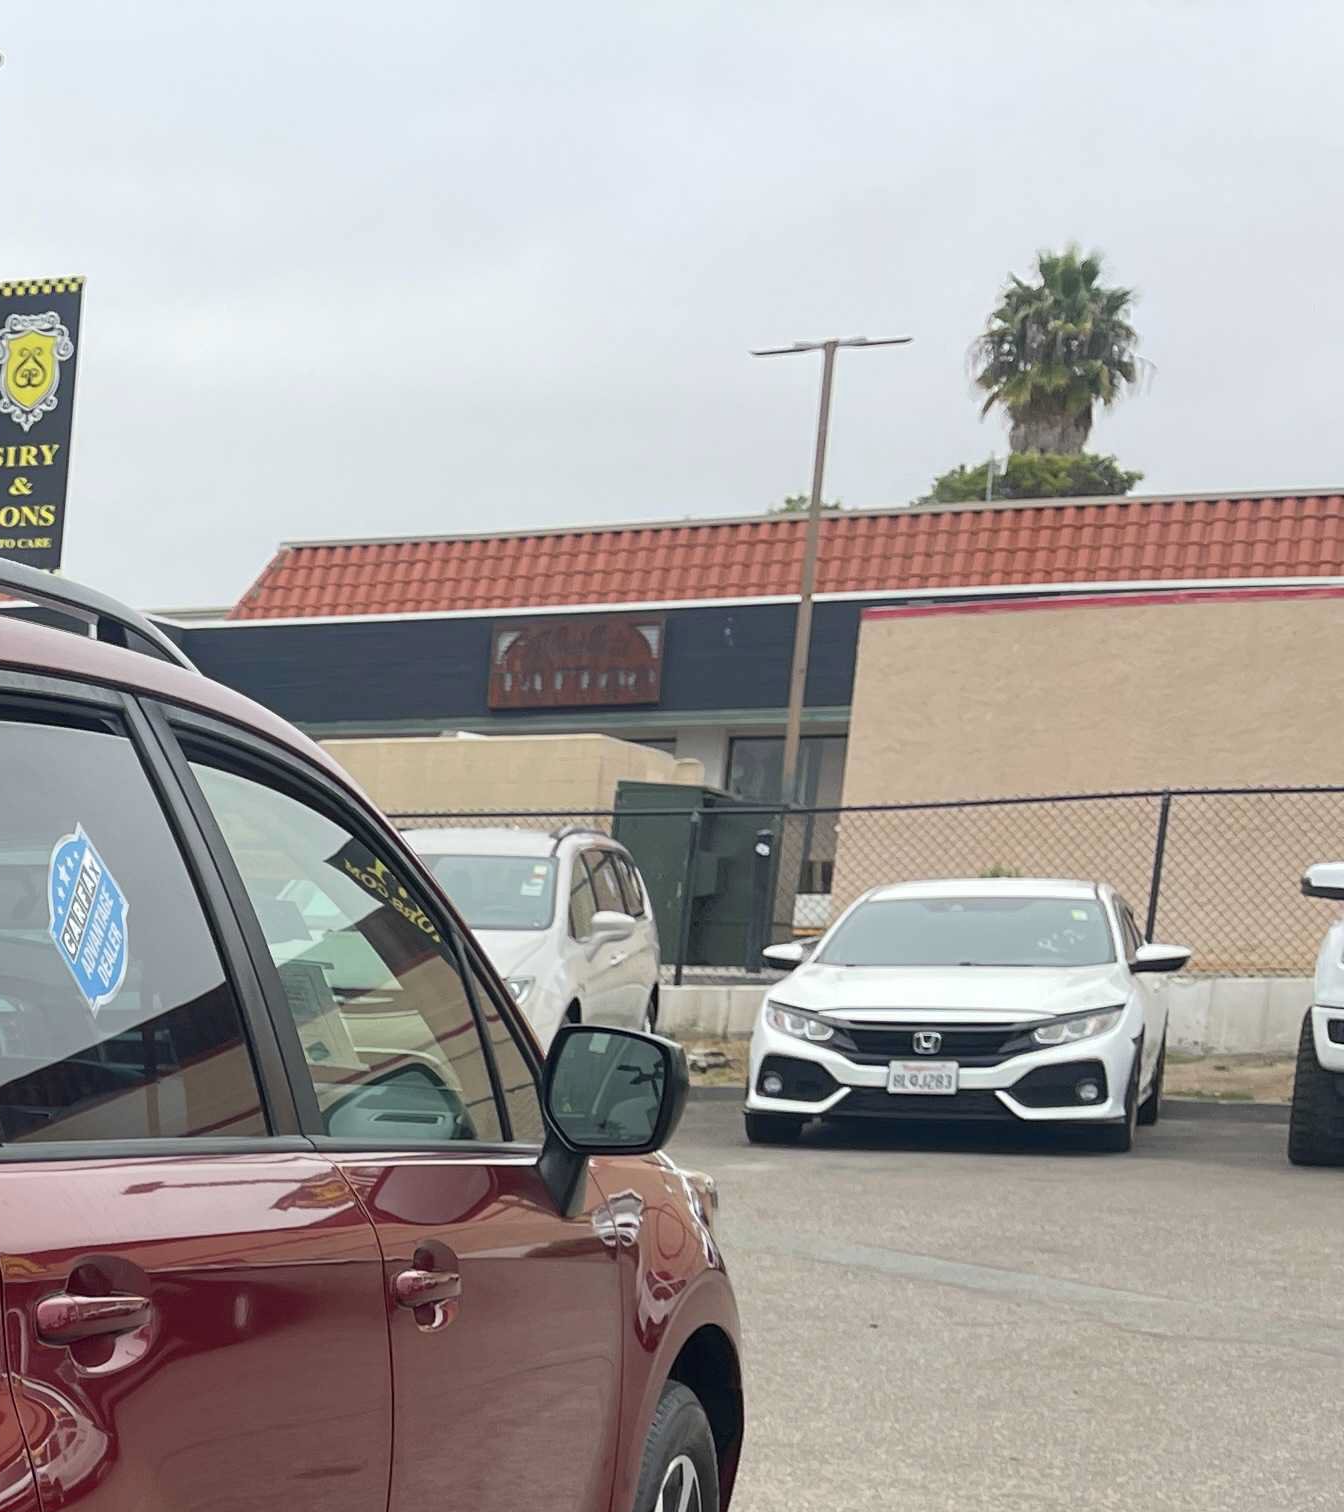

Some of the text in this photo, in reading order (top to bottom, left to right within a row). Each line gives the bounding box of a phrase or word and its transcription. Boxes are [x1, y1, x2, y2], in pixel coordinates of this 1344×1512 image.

[9, 477, 33, 496] &
[16, 537, 52, 549] CARE
[63, 857, 101, 956] CARFAX
[81, 882, 114, 980] ADVANTAGE
[97, 922, 123, 988] DEALER
